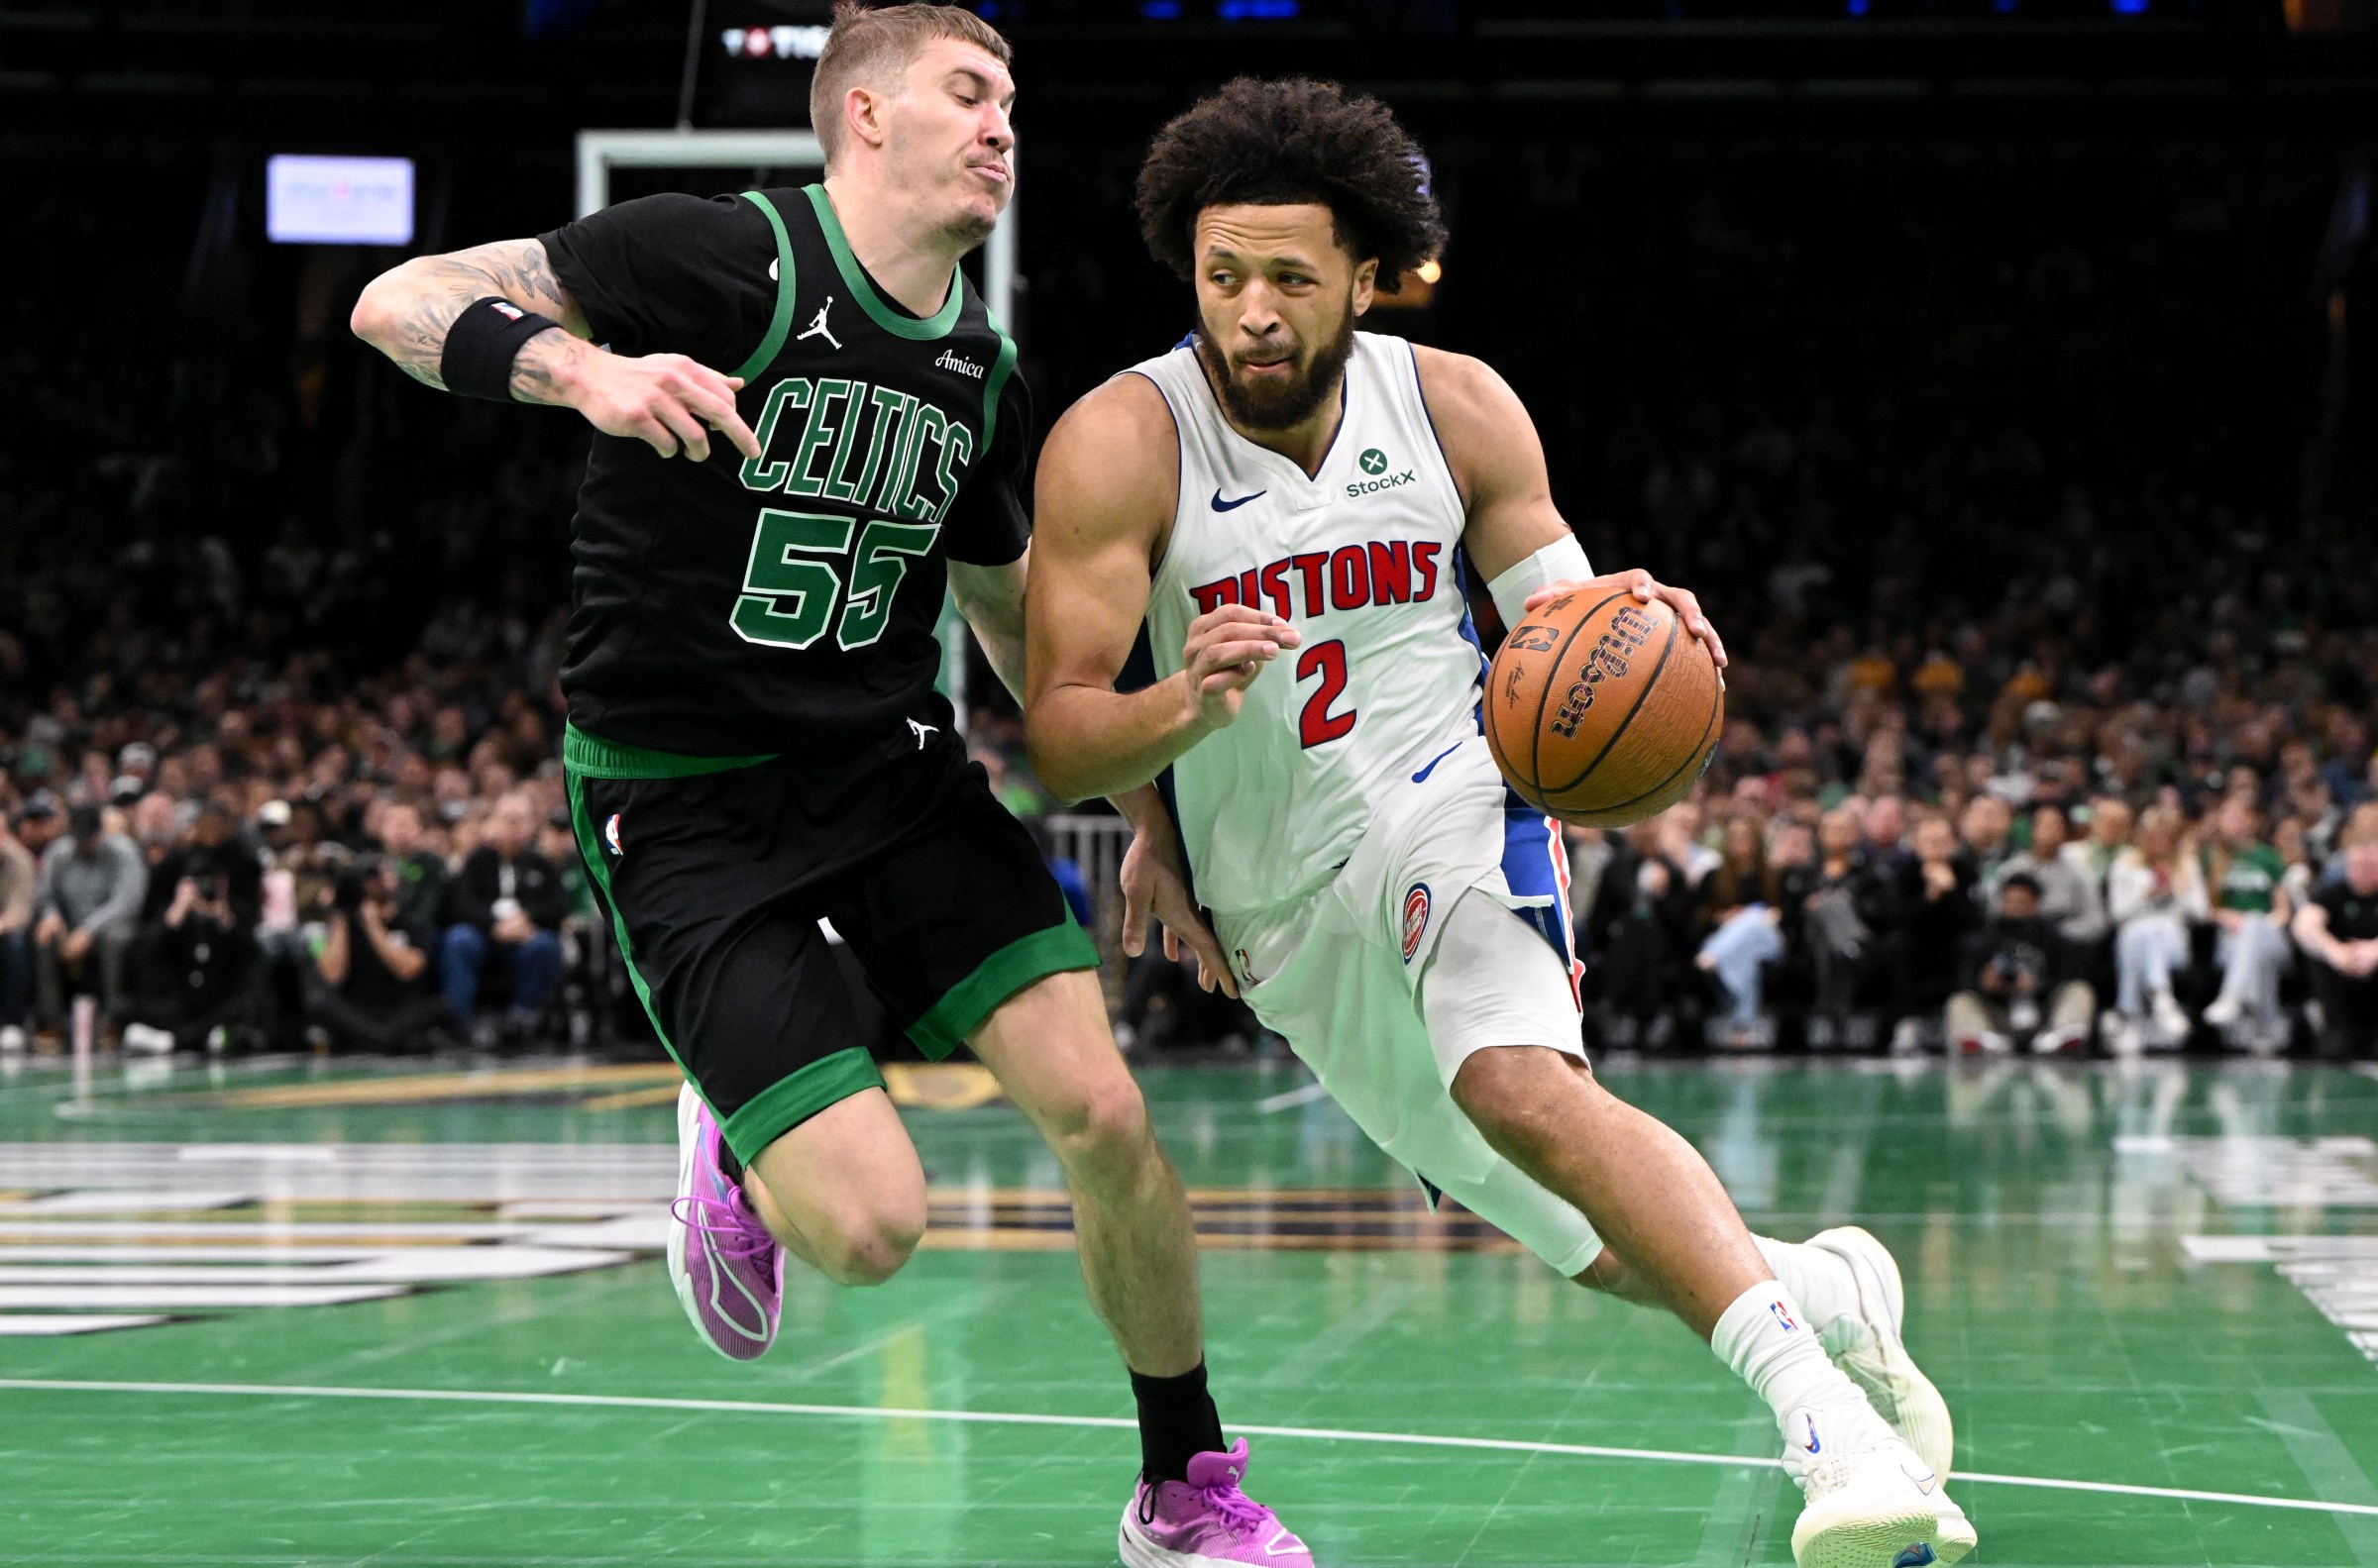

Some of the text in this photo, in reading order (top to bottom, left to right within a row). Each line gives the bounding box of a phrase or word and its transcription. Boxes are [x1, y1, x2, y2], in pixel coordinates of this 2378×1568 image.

[934, 349, 985, 379] Amica
[738, 376, 973, 523] CELTICS
[1347, 469, 1417, 497] StockX
[729, 507, 941, 653] 55
[1295, 638, 1357, 751] 2
[1549, 605, 1662, 742] Wilson
